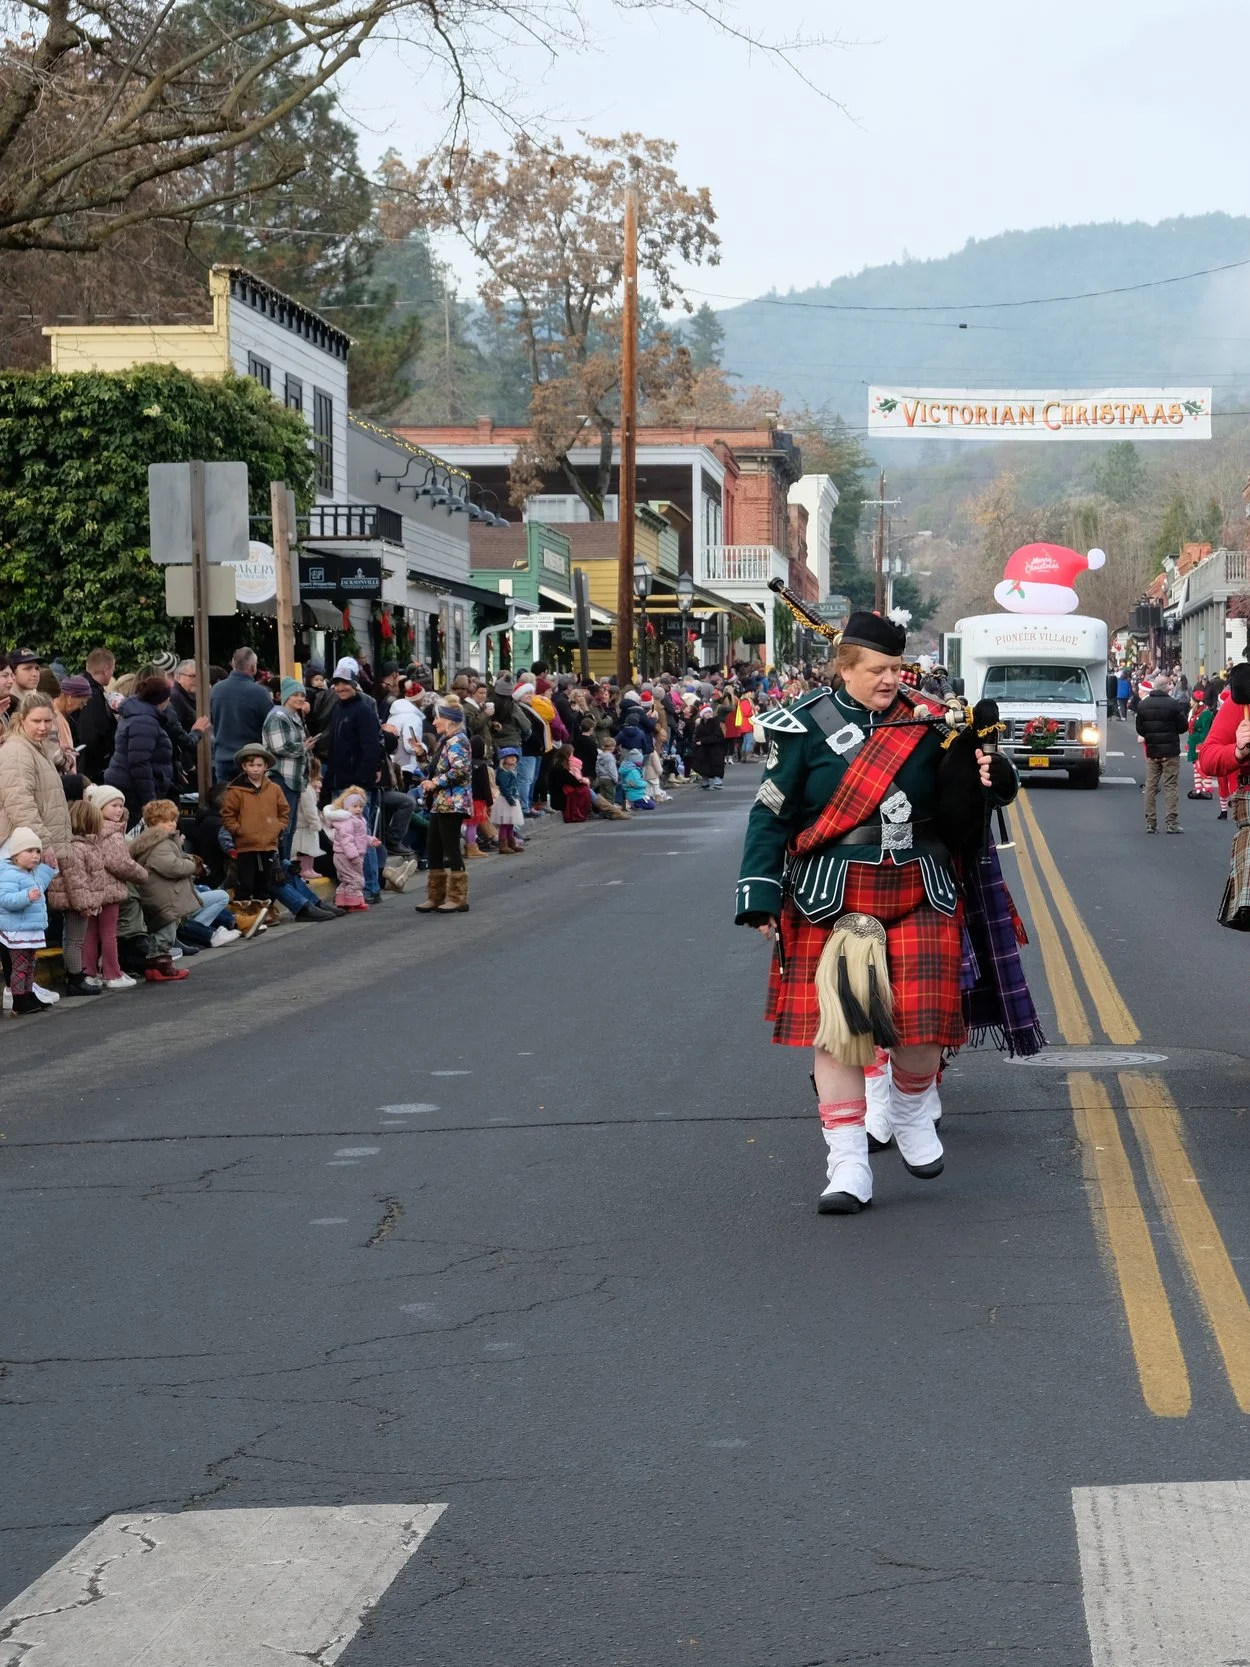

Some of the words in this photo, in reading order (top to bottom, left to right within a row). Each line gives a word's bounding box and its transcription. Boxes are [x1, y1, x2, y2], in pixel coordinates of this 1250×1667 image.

[902, 400, 1036, 427] VICTORIAN
[1043, 401, 1184, 430] CHRISTMAS
[995, 632, 1037, 646] PIONEER
[1039, 632, 1079, 646] VILLAGE
